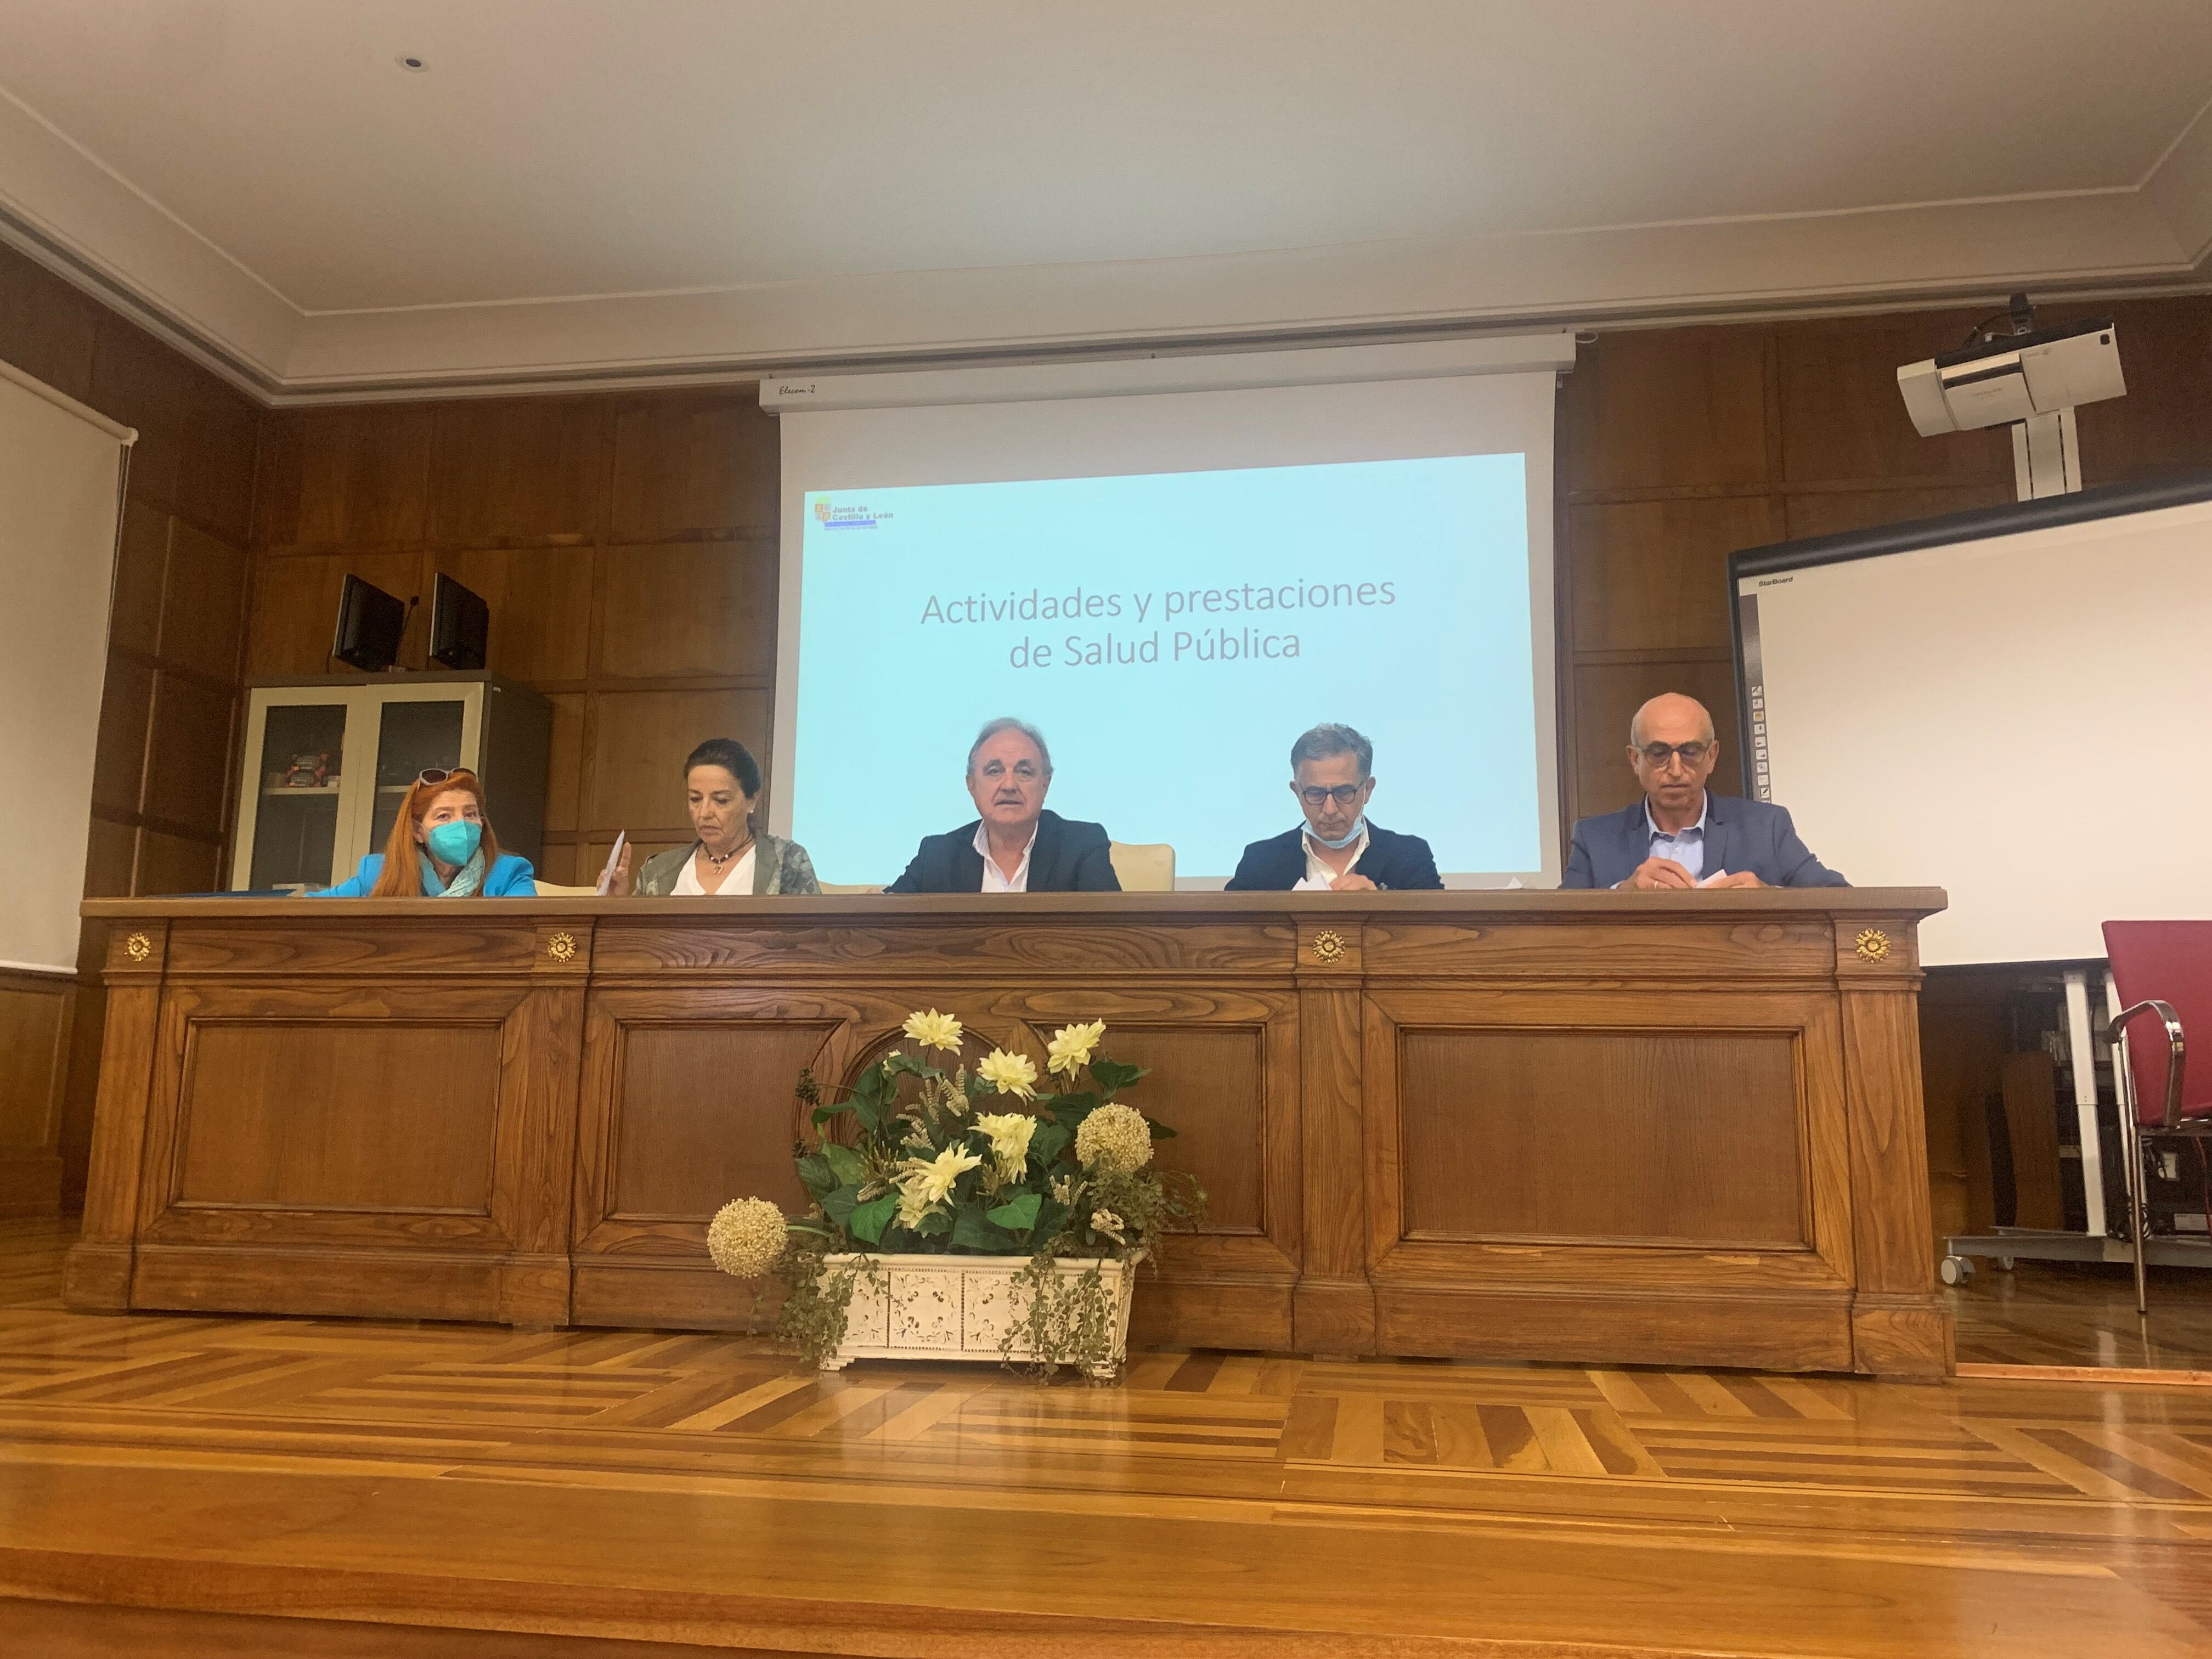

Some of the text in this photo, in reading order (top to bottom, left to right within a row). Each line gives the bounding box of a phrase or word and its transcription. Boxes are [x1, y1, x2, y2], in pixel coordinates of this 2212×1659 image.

[920, 578, 1396, 625] Actividades y prestaciones
[1758, 576, 1793, 588] StarBoard
[1010, 627, 1301, 669] de Salud Pública
